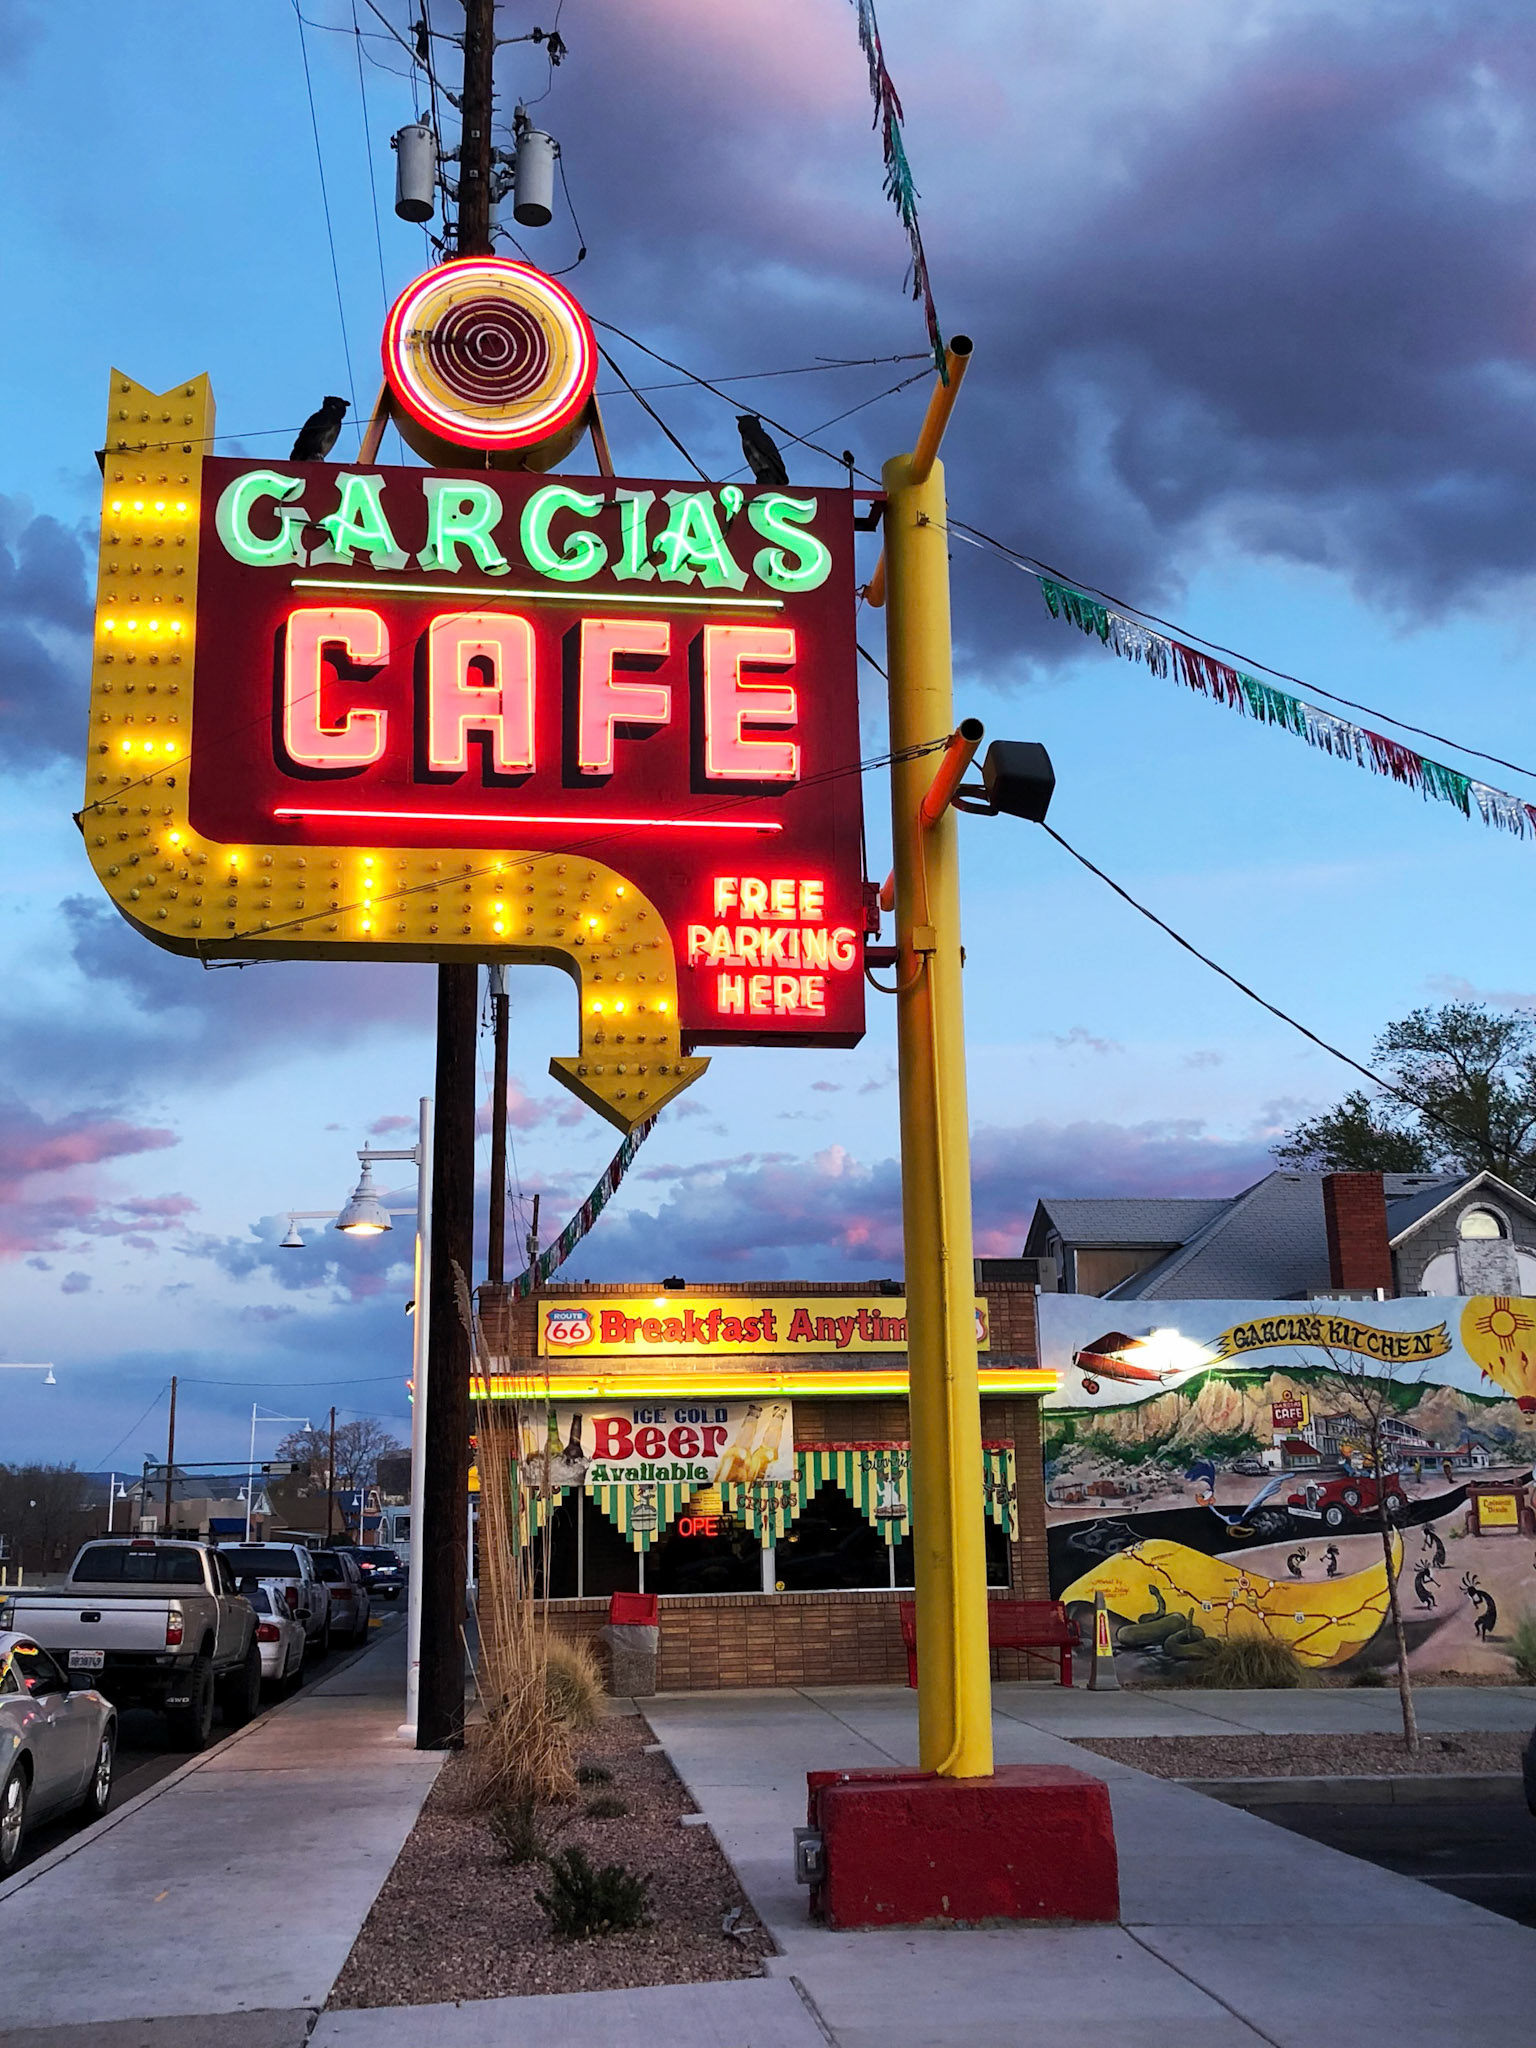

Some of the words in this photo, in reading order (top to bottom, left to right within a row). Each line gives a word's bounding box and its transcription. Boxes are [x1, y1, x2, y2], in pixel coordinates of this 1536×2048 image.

[214, 469, 833, 592] GARCIA'S
[281, 607, 801, 783] CAFE
[713, 876, 825, 921] FREE
[687, 924, 857, 972] PARKING
[716, 973, 826, 1017] HERE
[552, 1322, 585, 1340] 66
[599, 1308, 778, 1345] Breakfast
[786, 1308, 908, 1349] Anytim
[1233, 1317, 1325, 1349] GARCIA'S
[1328, 1319, 1435, 1357] KITCHEN
[633, 1407, 667, 1424] ICE
[674, 1407, 728, 1423] COLD
[1274, 1408, 1303, 1420] CAFE
[591, 1416, 728, 1460] Beer
[591, 1461, 709, 1482] Available
